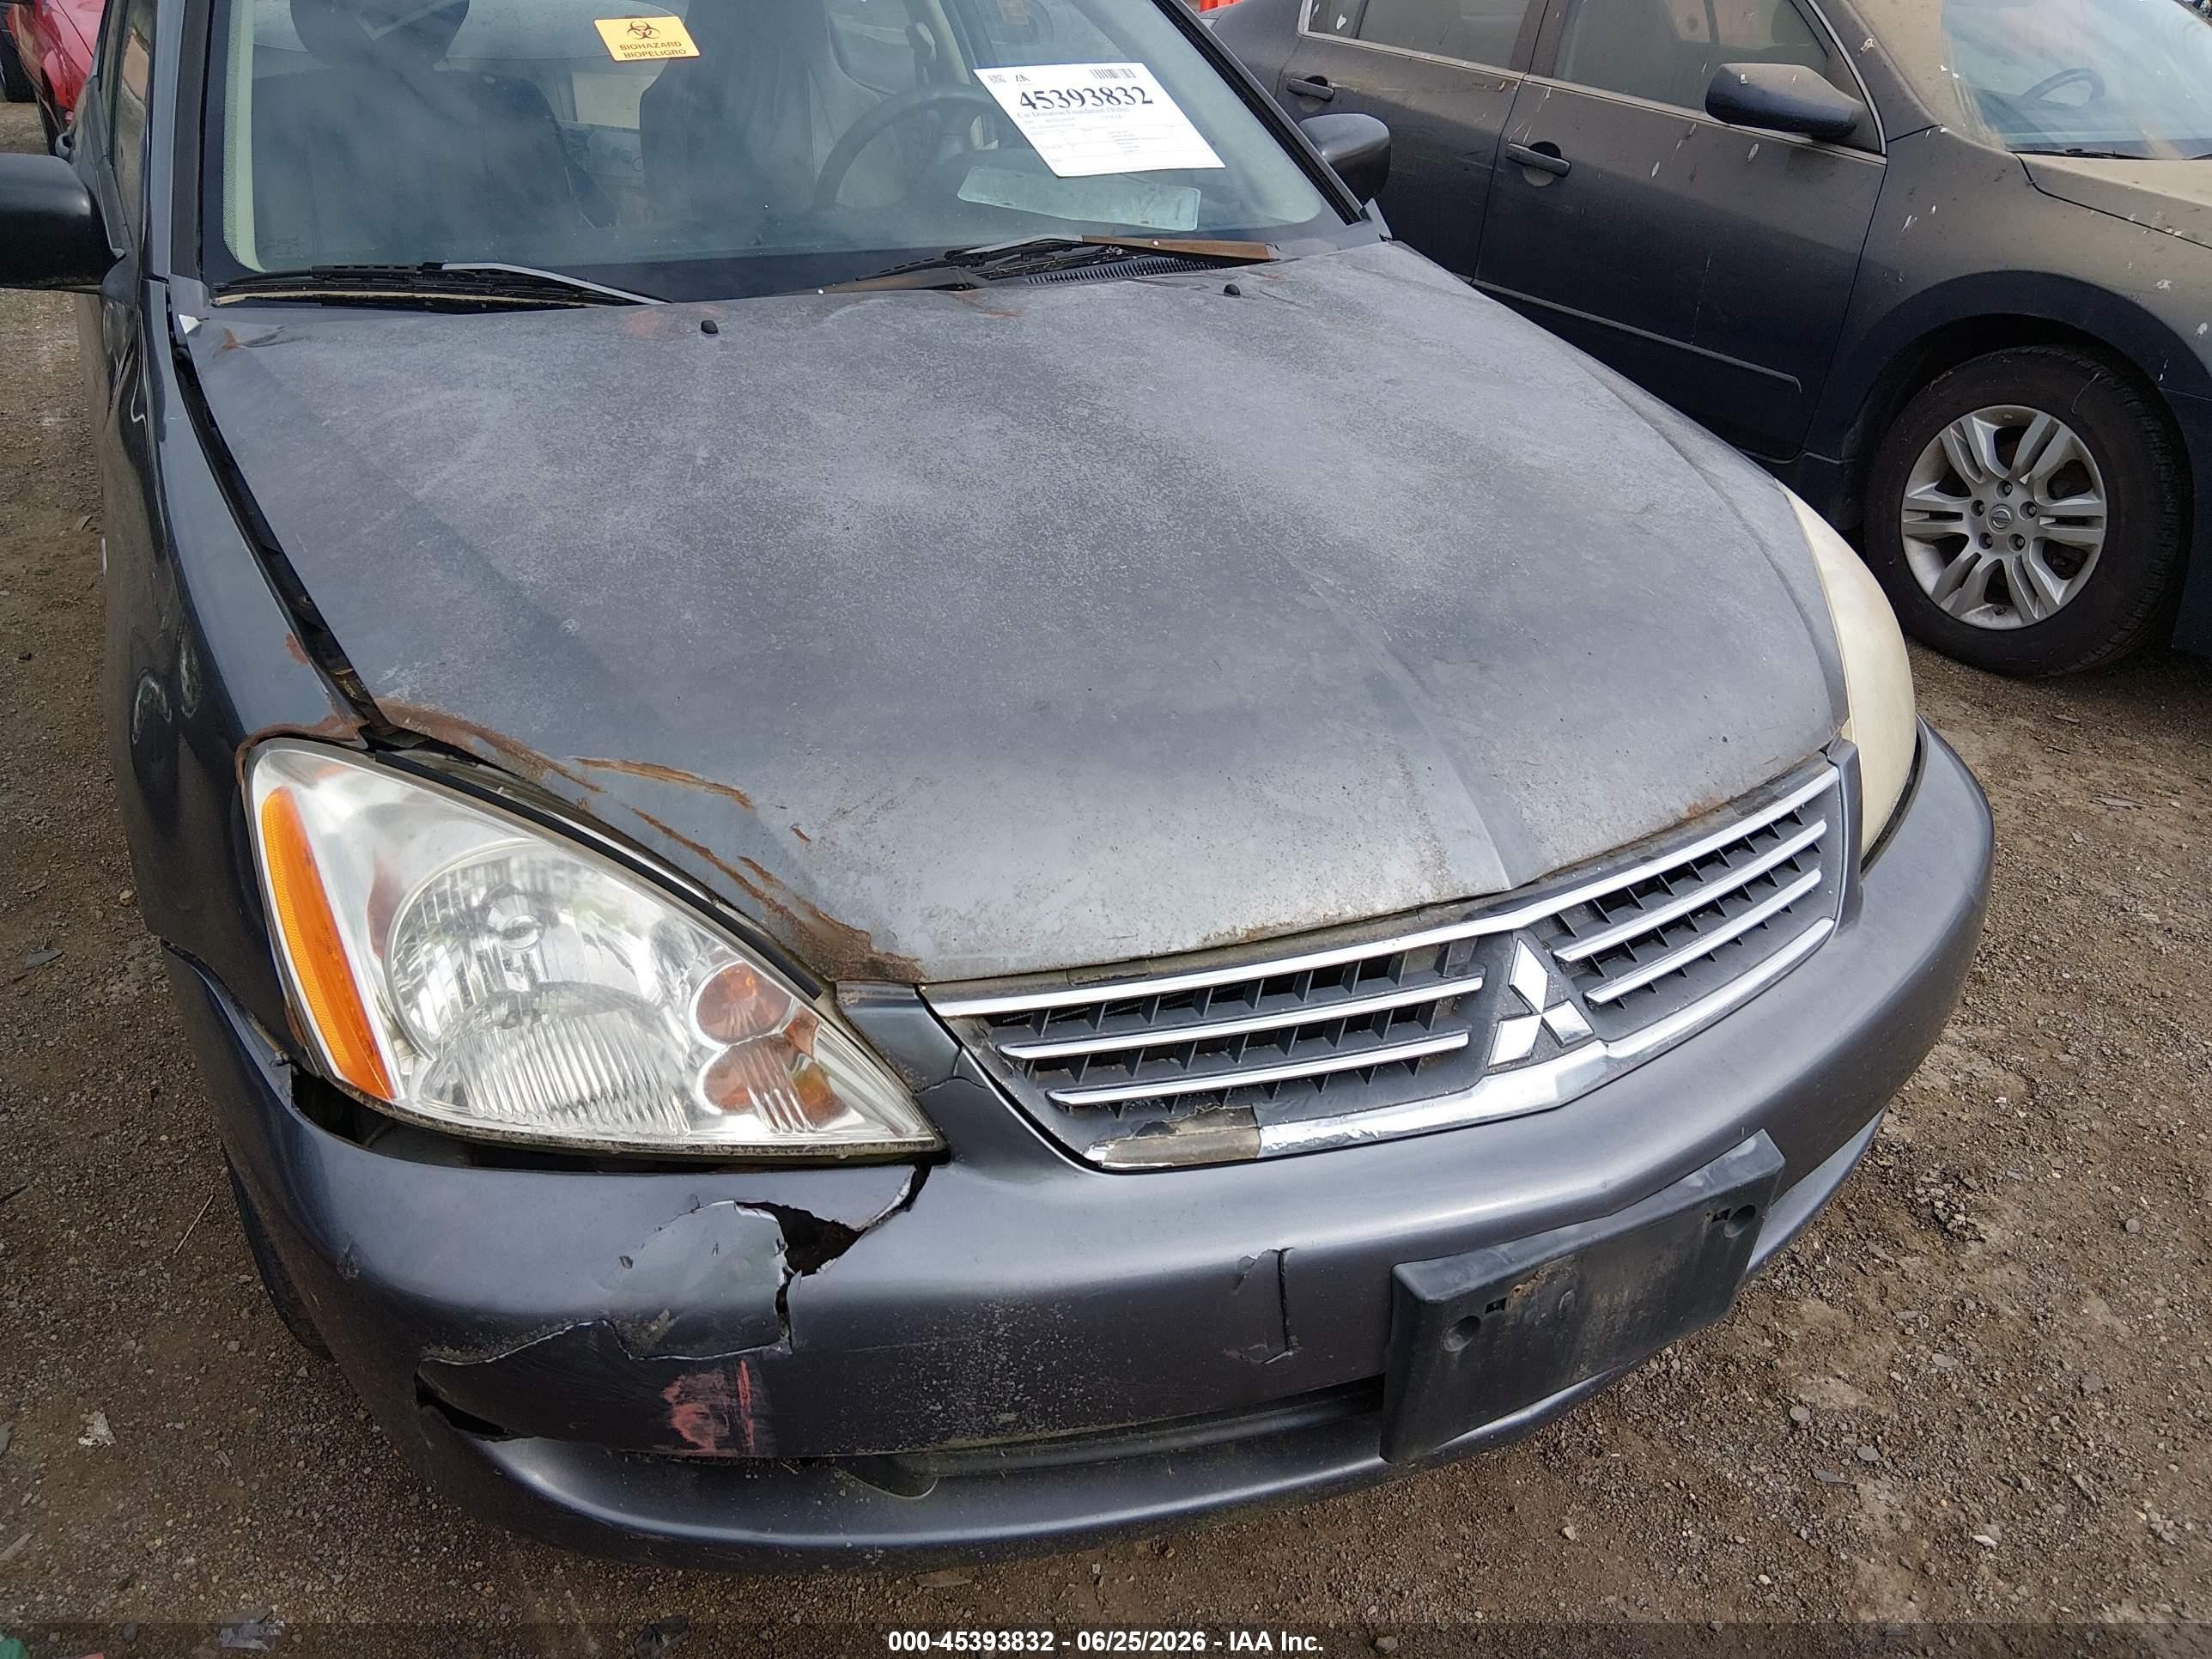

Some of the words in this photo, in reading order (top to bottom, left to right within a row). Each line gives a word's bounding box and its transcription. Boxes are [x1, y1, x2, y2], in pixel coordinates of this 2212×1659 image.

[619, 41, 682, 51] BIOHAZARD
[623, 49, 687, 58] BIOPELIGRO
[1019, 86, 1154, 110] 45393832
